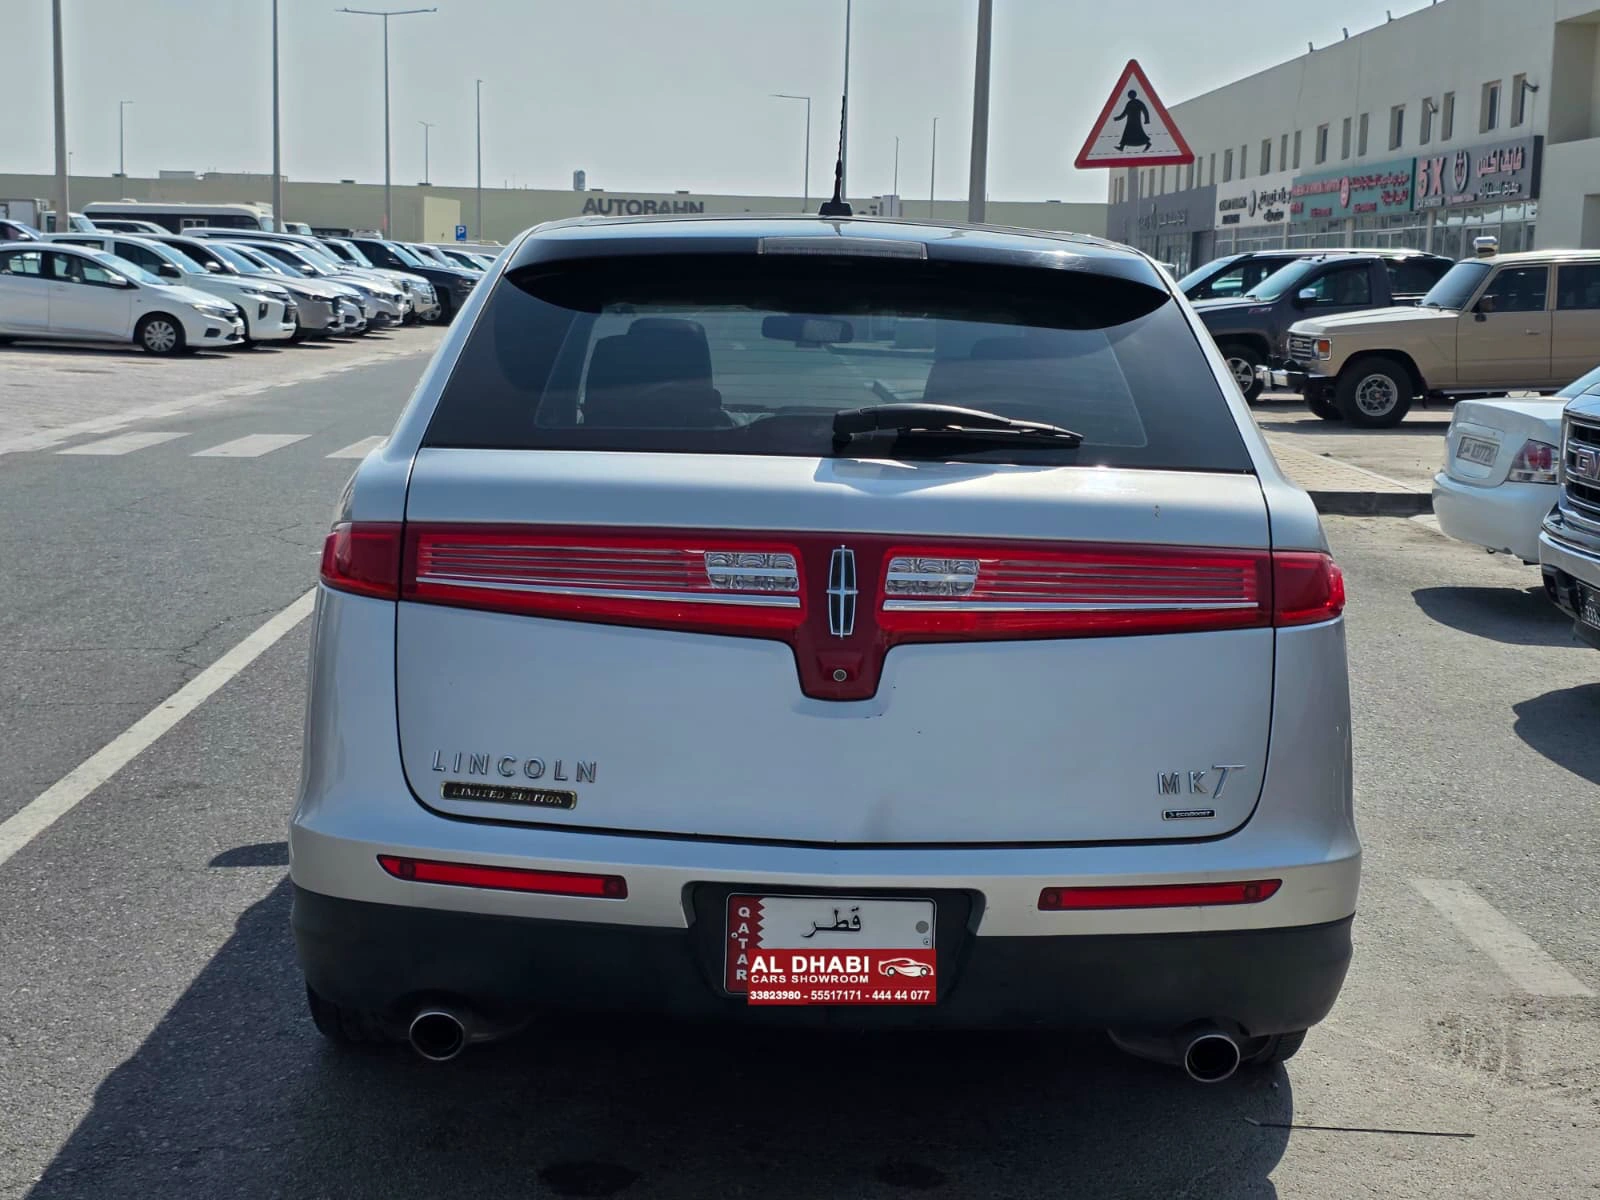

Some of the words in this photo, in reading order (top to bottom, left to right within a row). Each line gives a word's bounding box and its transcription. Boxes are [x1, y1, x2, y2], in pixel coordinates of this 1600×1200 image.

[582, 198, 705, 216] AUTOBAHN
[457, 226, 465, 237] P
[432, 749, 598, 784] LINCOLN
[1157, 764, 1247, 799] MKT
[452, 787, 505, 800] LIMITED
[510, 791, 563, 804] EDITION
[801, 905, 862, 939] قطر
[736, 907, 751, 981] QATAR
